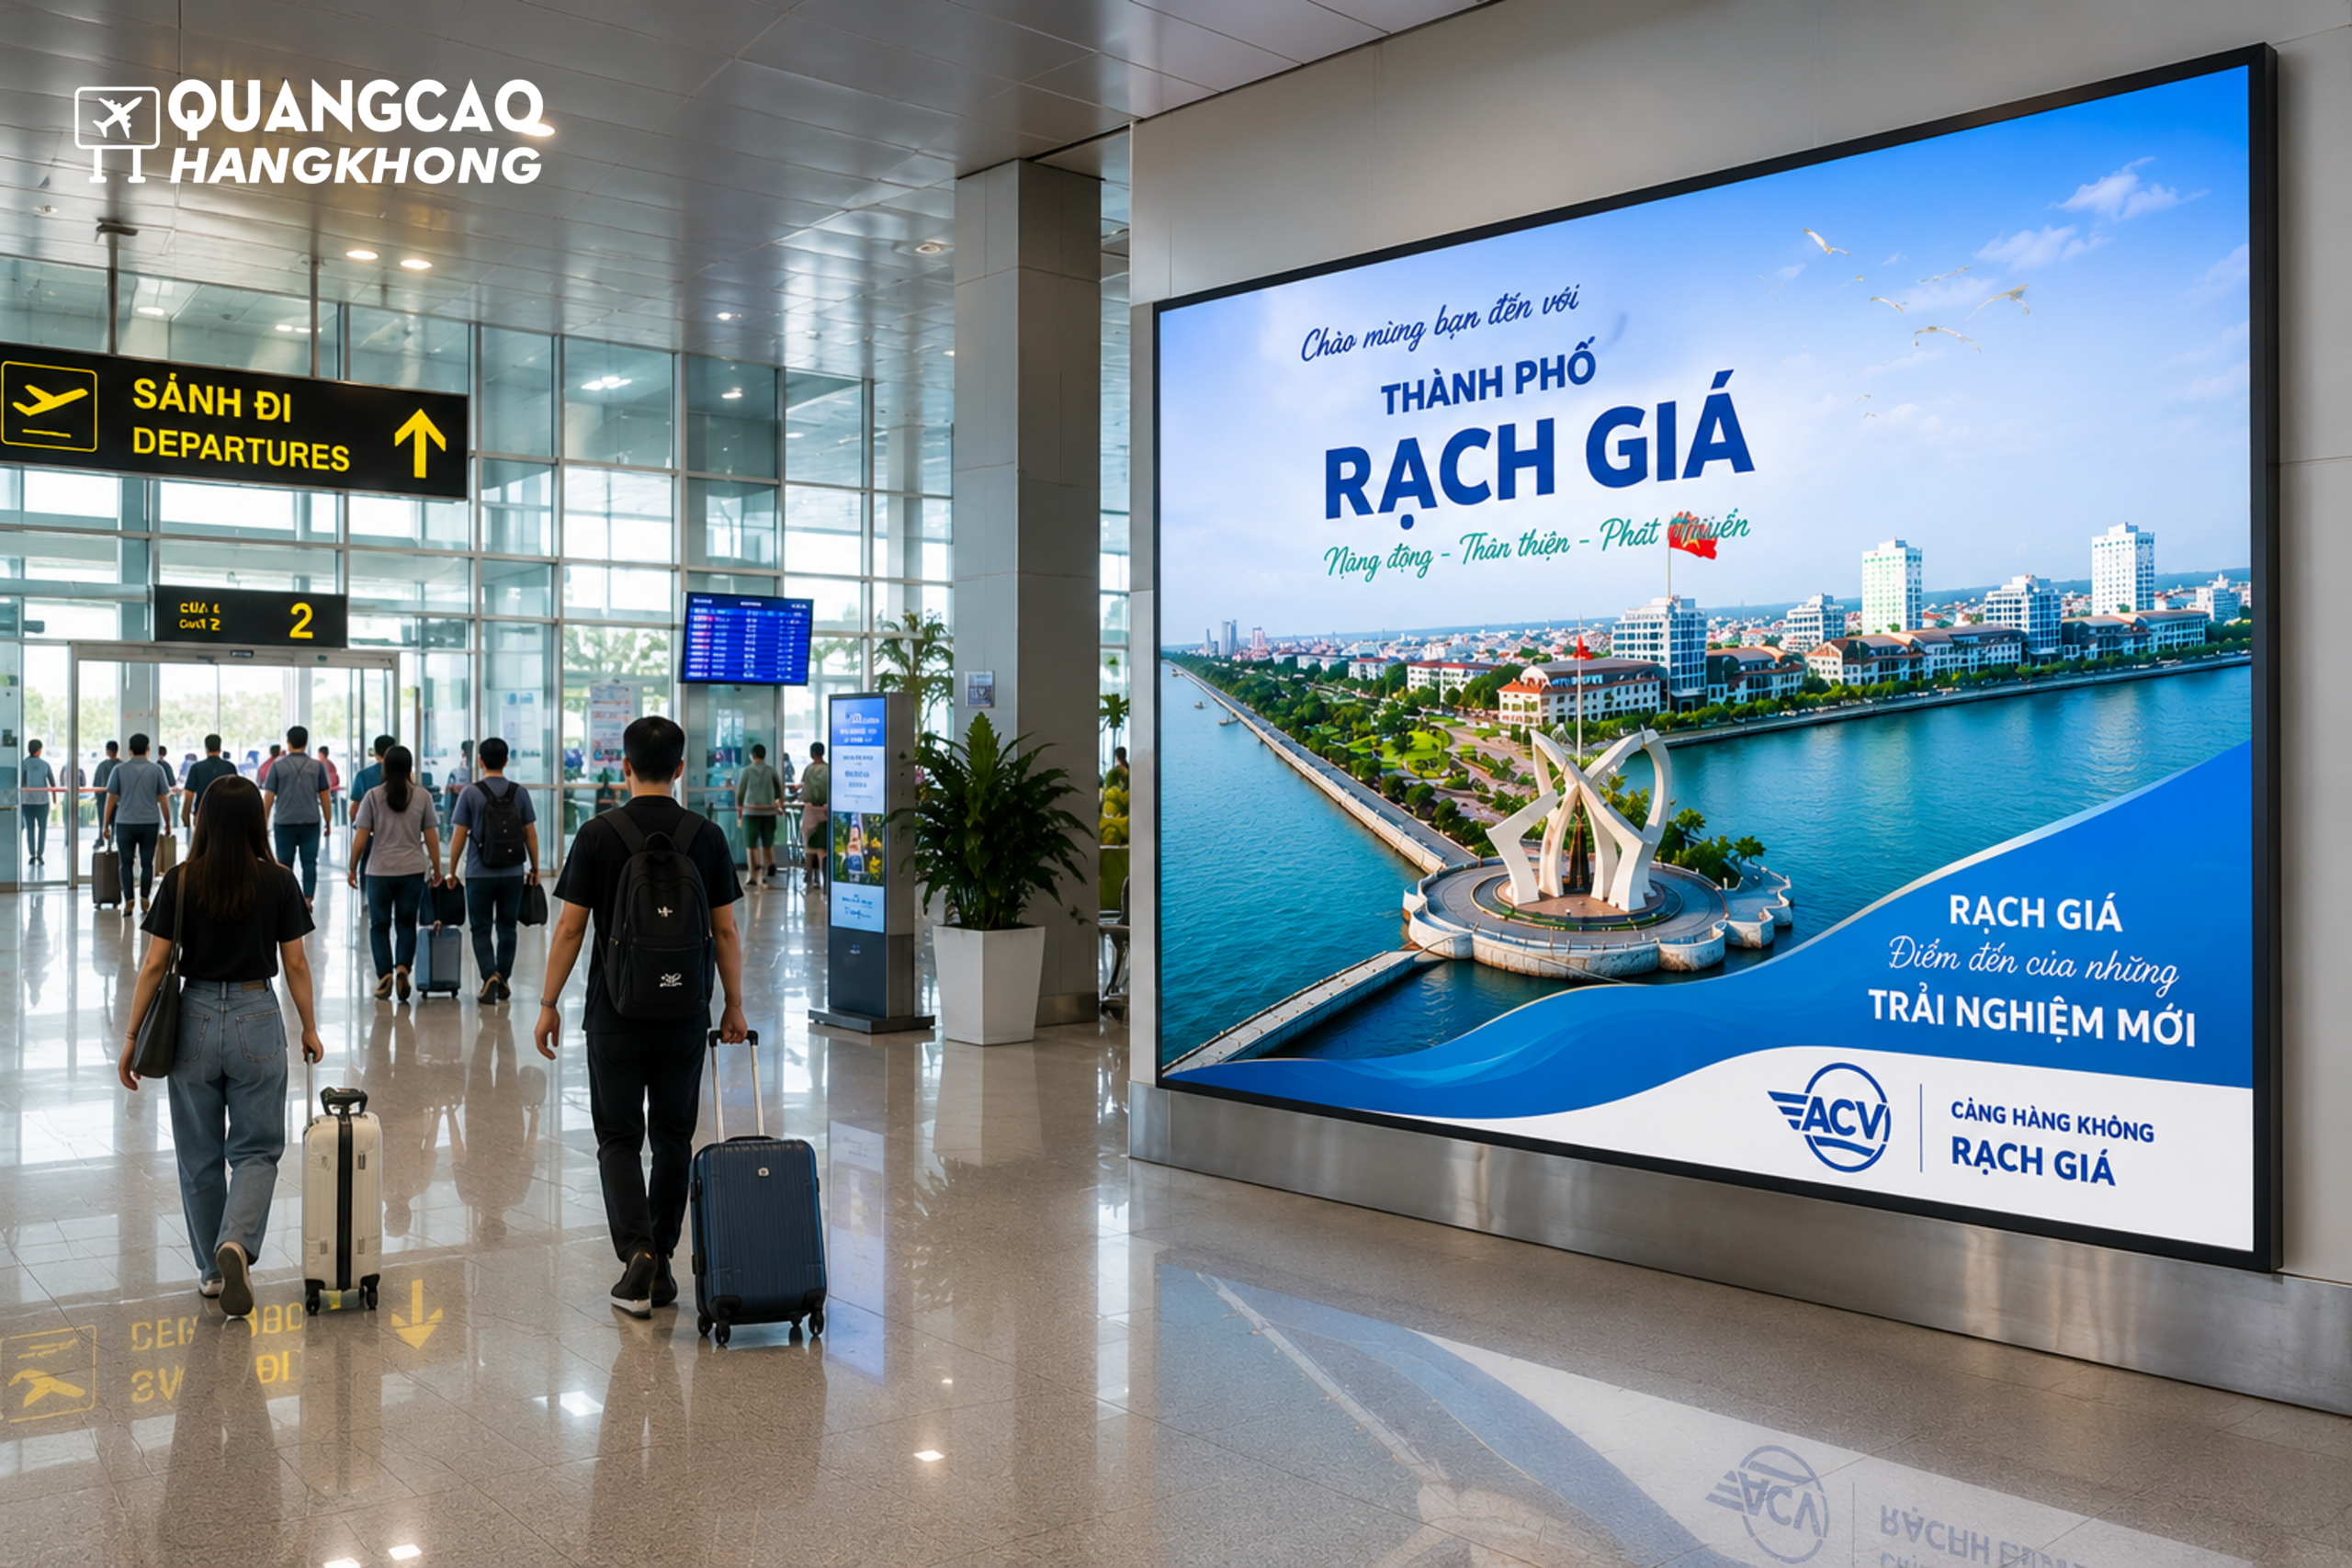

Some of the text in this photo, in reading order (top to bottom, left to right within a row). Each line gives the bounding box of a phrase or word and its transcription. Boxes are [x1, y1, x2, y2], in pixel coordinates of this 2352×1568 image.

[1301, 327, 1356, 362] Chào
[1434, 304, 1481, 340] bạn
[1488, 292, 1534, 325] đến
[1542, 284, 1580, 315] với
[132, 372, 291, 423] SẢNH ĐI
[1380, 335, 1597, 415] THÀNH PHỐ
[133, 426, 350, 472] DEPARTURES
[1325, 369, 1755, 530] RẠCH GIÁ
[1386, 543, 1433, 579] động
[1459, 532, 1512, 565] Thân
[1518, 528, 1570, 561] thiện
[288, 603, 313, 639] 2
[1951, 892, 2123, 934] RẠCH GIÁ
[1969, 942, 2018, 974] đến
[1868, 982, 2196, 1048] TRẢI NGHIỆM MỚI
[1802, 1096, 1887, 1140] ACV
[2013, 1105, 2071, 1133] HÀNG
[2077, 1114, 2154, 1143] KHÔNG
[1952, 1136, 2116, 1187] RẠCH GIÁ
